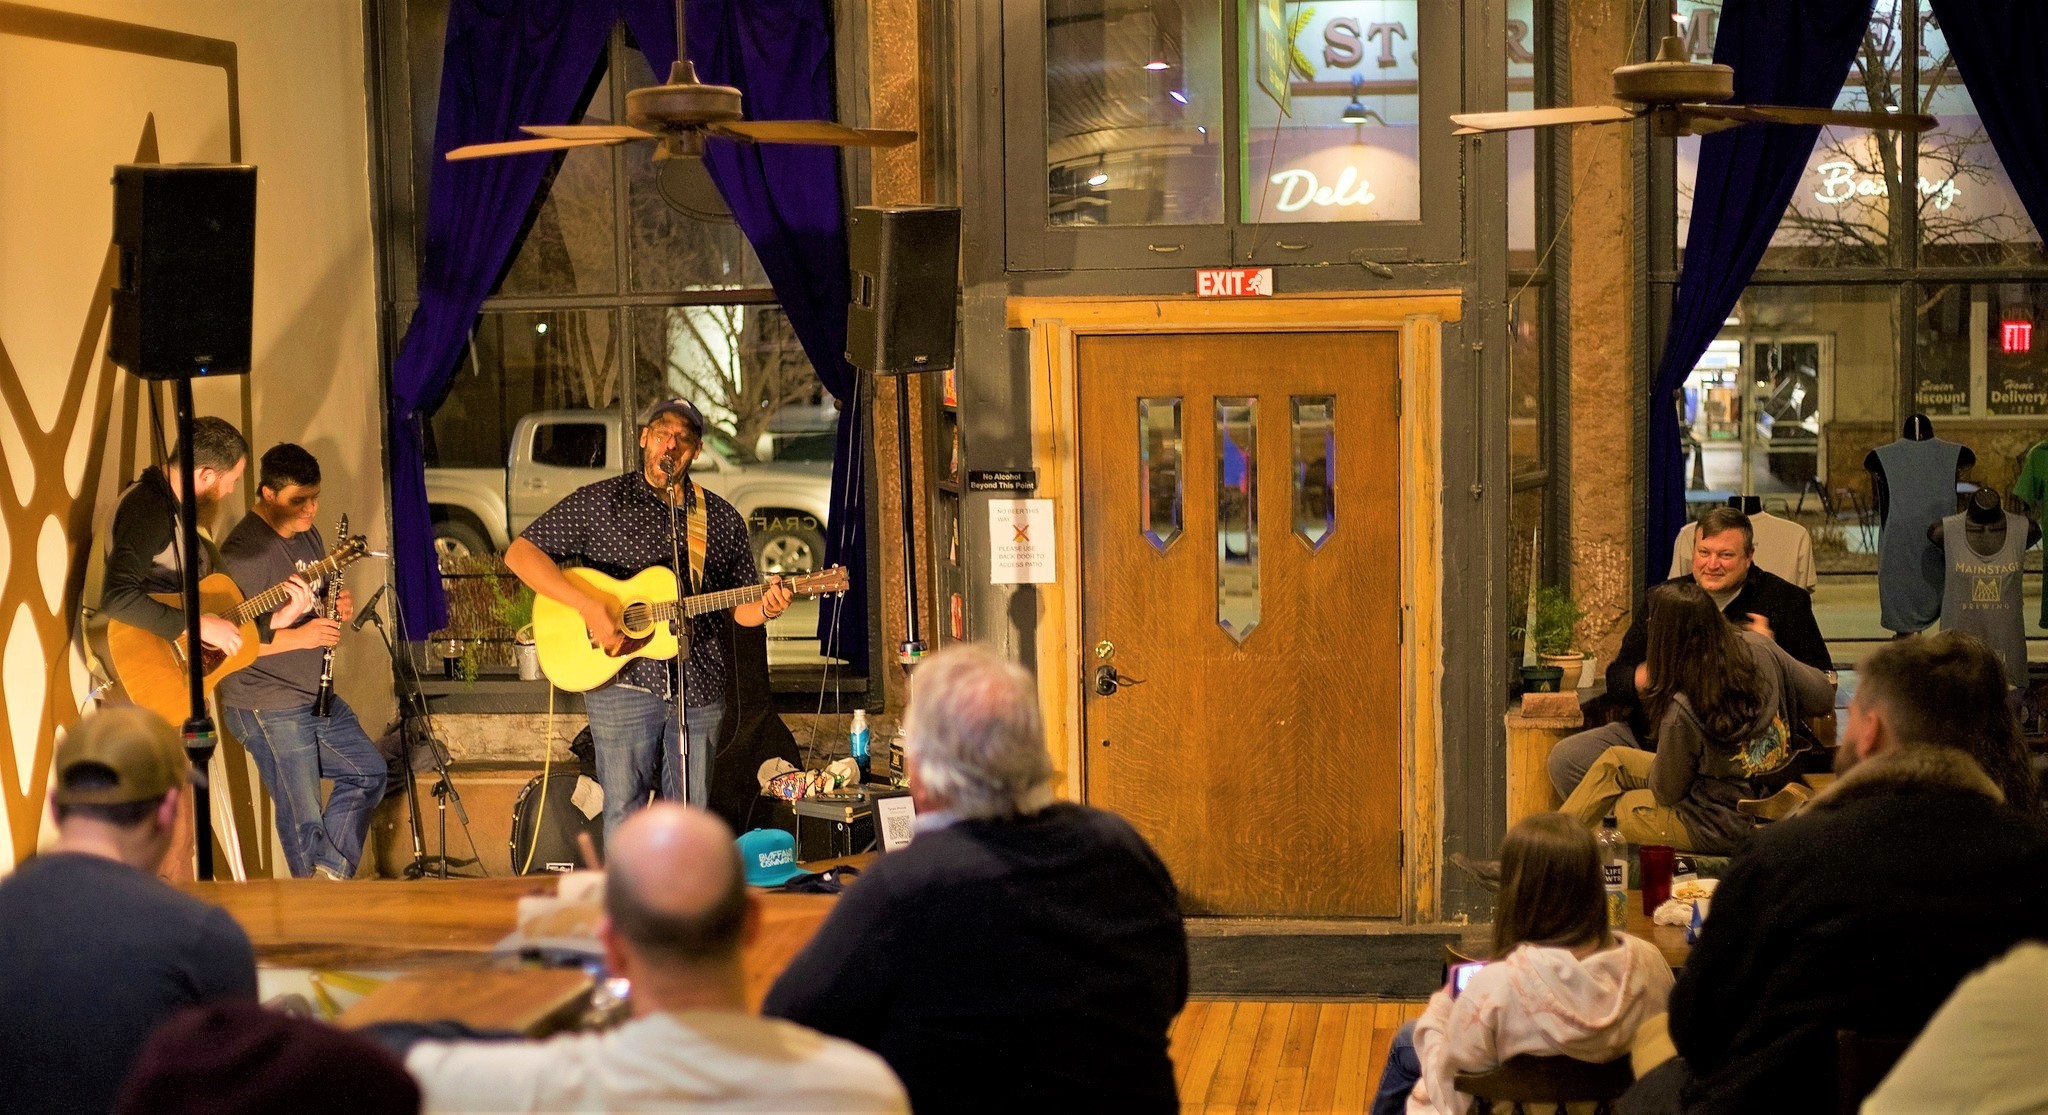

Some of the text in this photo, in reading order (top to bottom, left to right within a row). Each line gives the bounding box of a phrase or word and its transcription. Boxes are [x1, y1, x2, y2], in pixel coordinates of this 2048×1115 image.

[1271, 165, 1375, 212] Deli
[1199, 271, 1245, 295] EXIT
[1916, 391, 1967, 404] iscount
[1991, 391, 2047, 405] Delivery
[970, 481, 1034, 490] Beyond This Point
